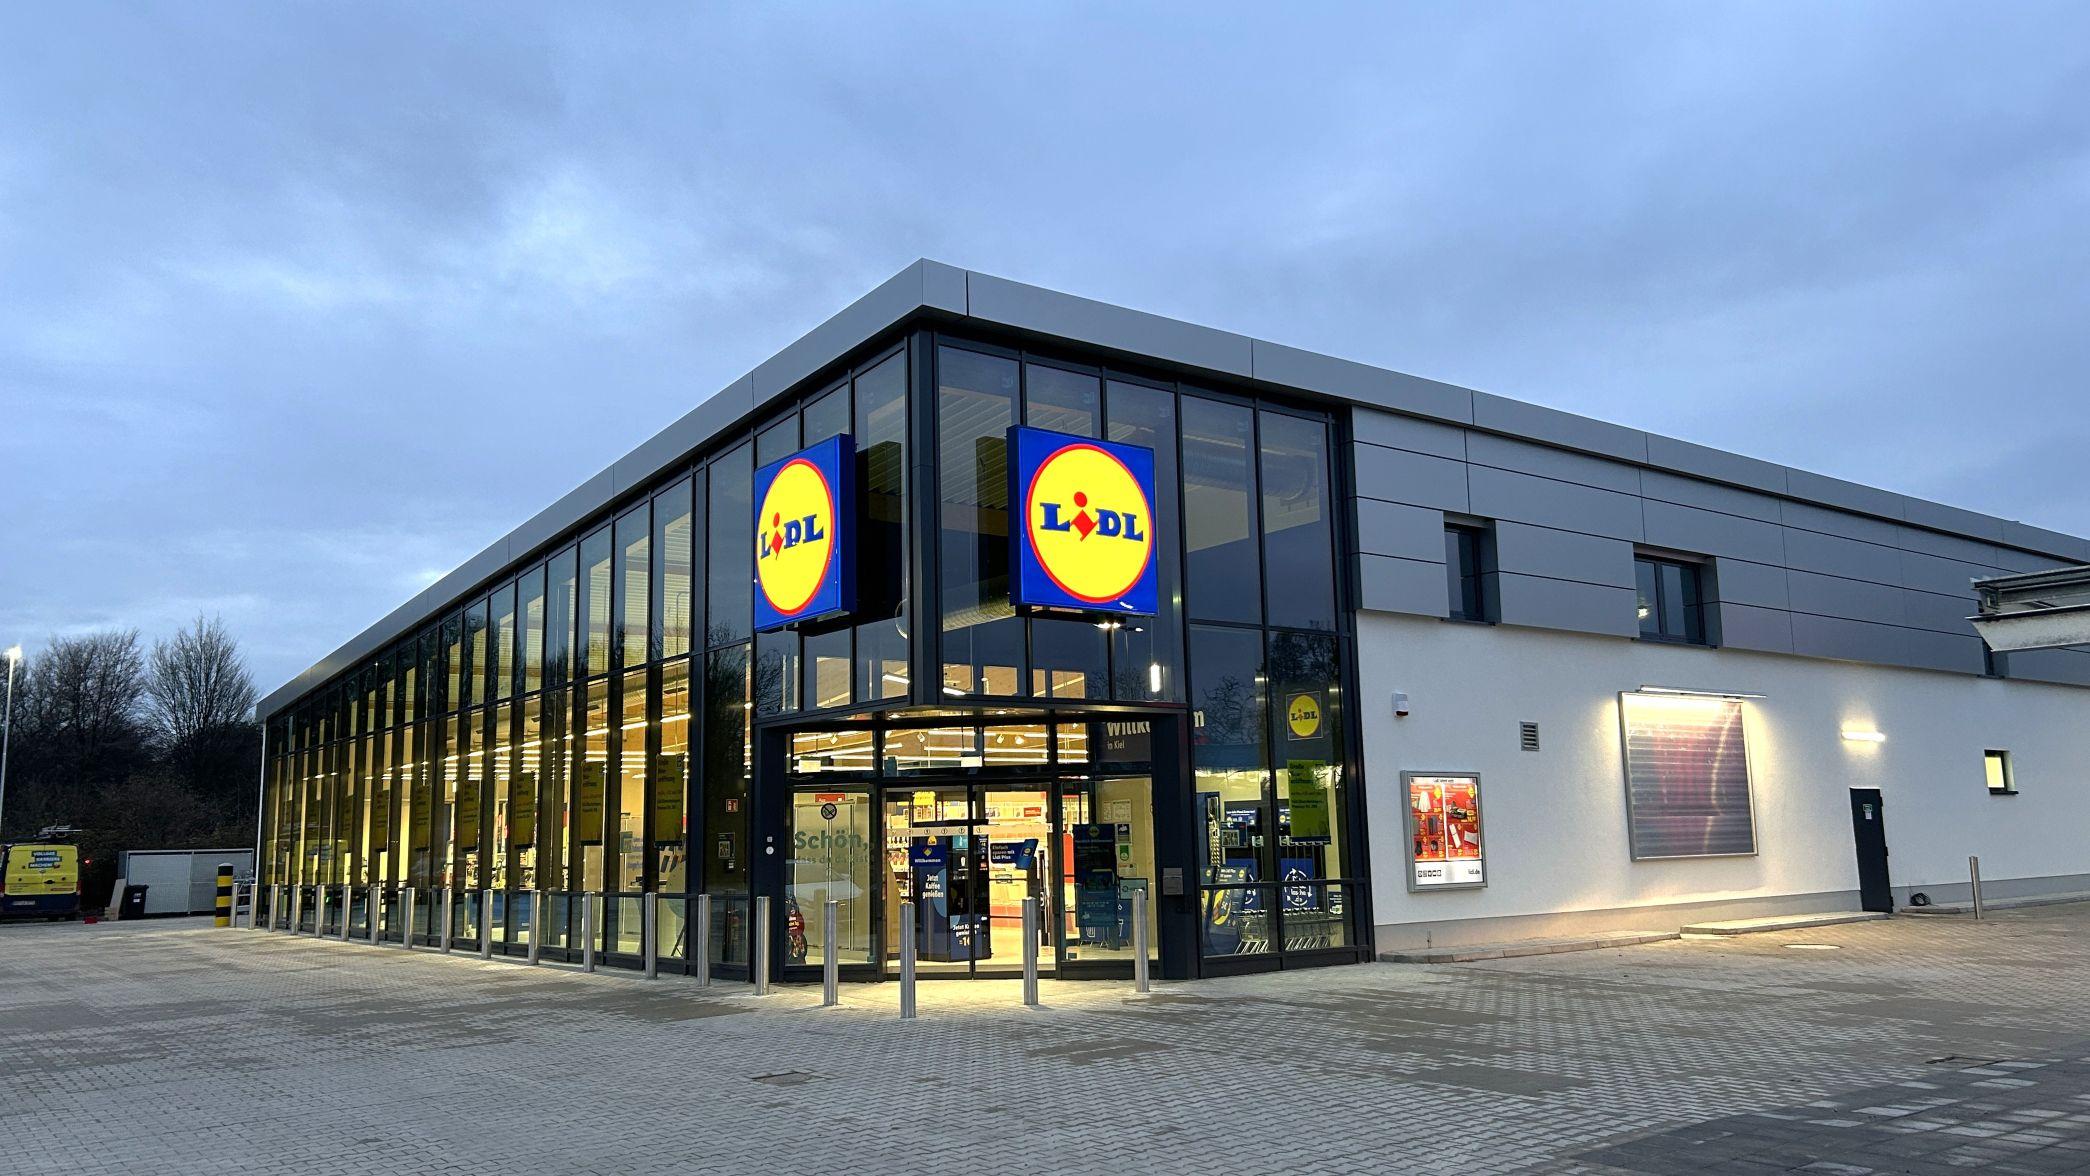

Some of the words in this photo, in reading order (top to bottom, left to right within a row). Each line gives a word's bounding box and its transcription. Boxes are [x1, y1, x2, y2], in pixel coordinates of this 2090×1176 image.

[1113, 740, 1125, 749] Kiel
[794, 829, 869, 851] Schön,
[926, 874, 939, 882] Jetzt
[925, 882, 941, 890] Kaffee
